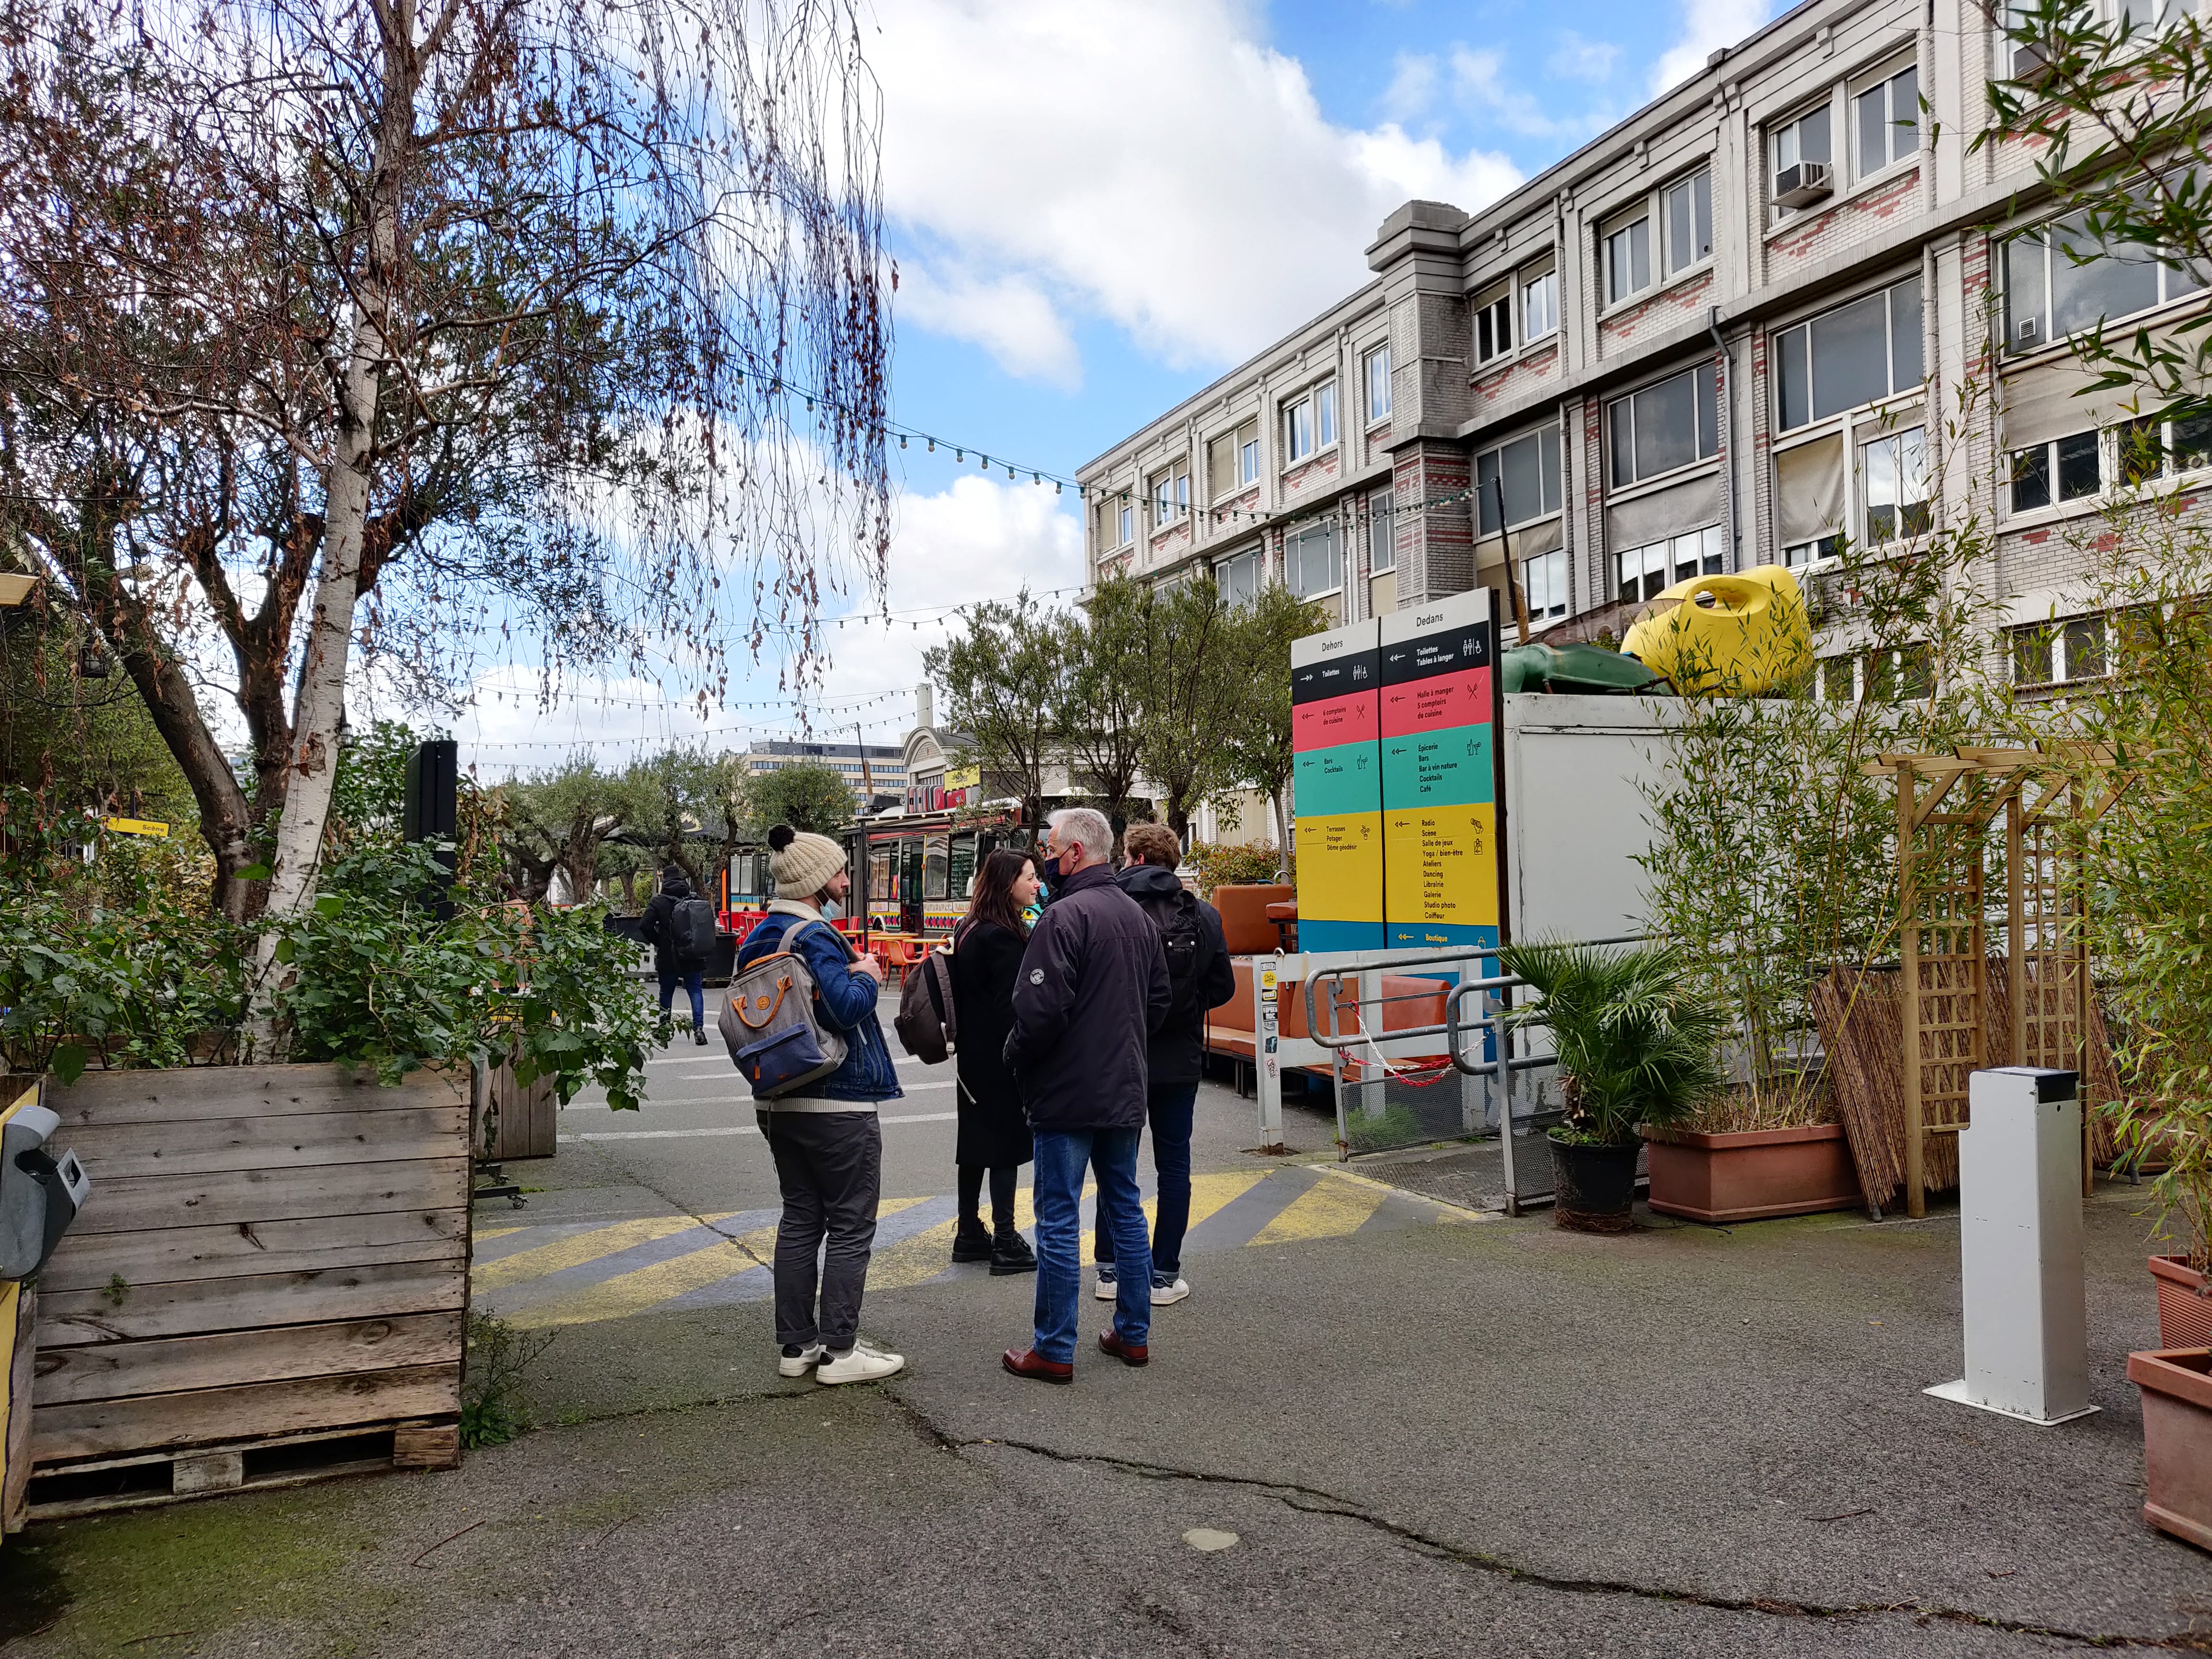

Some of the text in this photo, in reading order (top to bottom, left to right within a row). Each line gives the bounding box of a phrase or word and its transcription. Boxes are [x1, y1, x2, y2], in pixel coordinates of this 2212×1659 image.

[1417, 613, 1443, 627] Dedans
[1322, 640, 1343, 652] Dehors
[1417, 647, 1438, 656] Toilettes
[1417, 657, 1433, 666] Tables
[1438, 653, 1454, 662] langer
[1322, 669, 1340, 678] Toilettes
[1417, 690, 1430, 698] Halle
[1434, 686, 1454, 695] manger
[1421, 698, 1446, 708] comptoirs
[1326, 707, 1346, 716] comptoirs
[1424, 709, 1442, 718] cuisine
[1329, 716, 1343, 724] cuisine
[1418, 743, 1438, 753] Épicerie
[1419, 774, 1443, 782] Cocktails
[1442, 839, 1453, 848] jeux
[1422, 850, 1435, 858] Yoga
[1423, 870, 1443, 878] Dancing
[1425, 934, 1448, 943] Boutique
